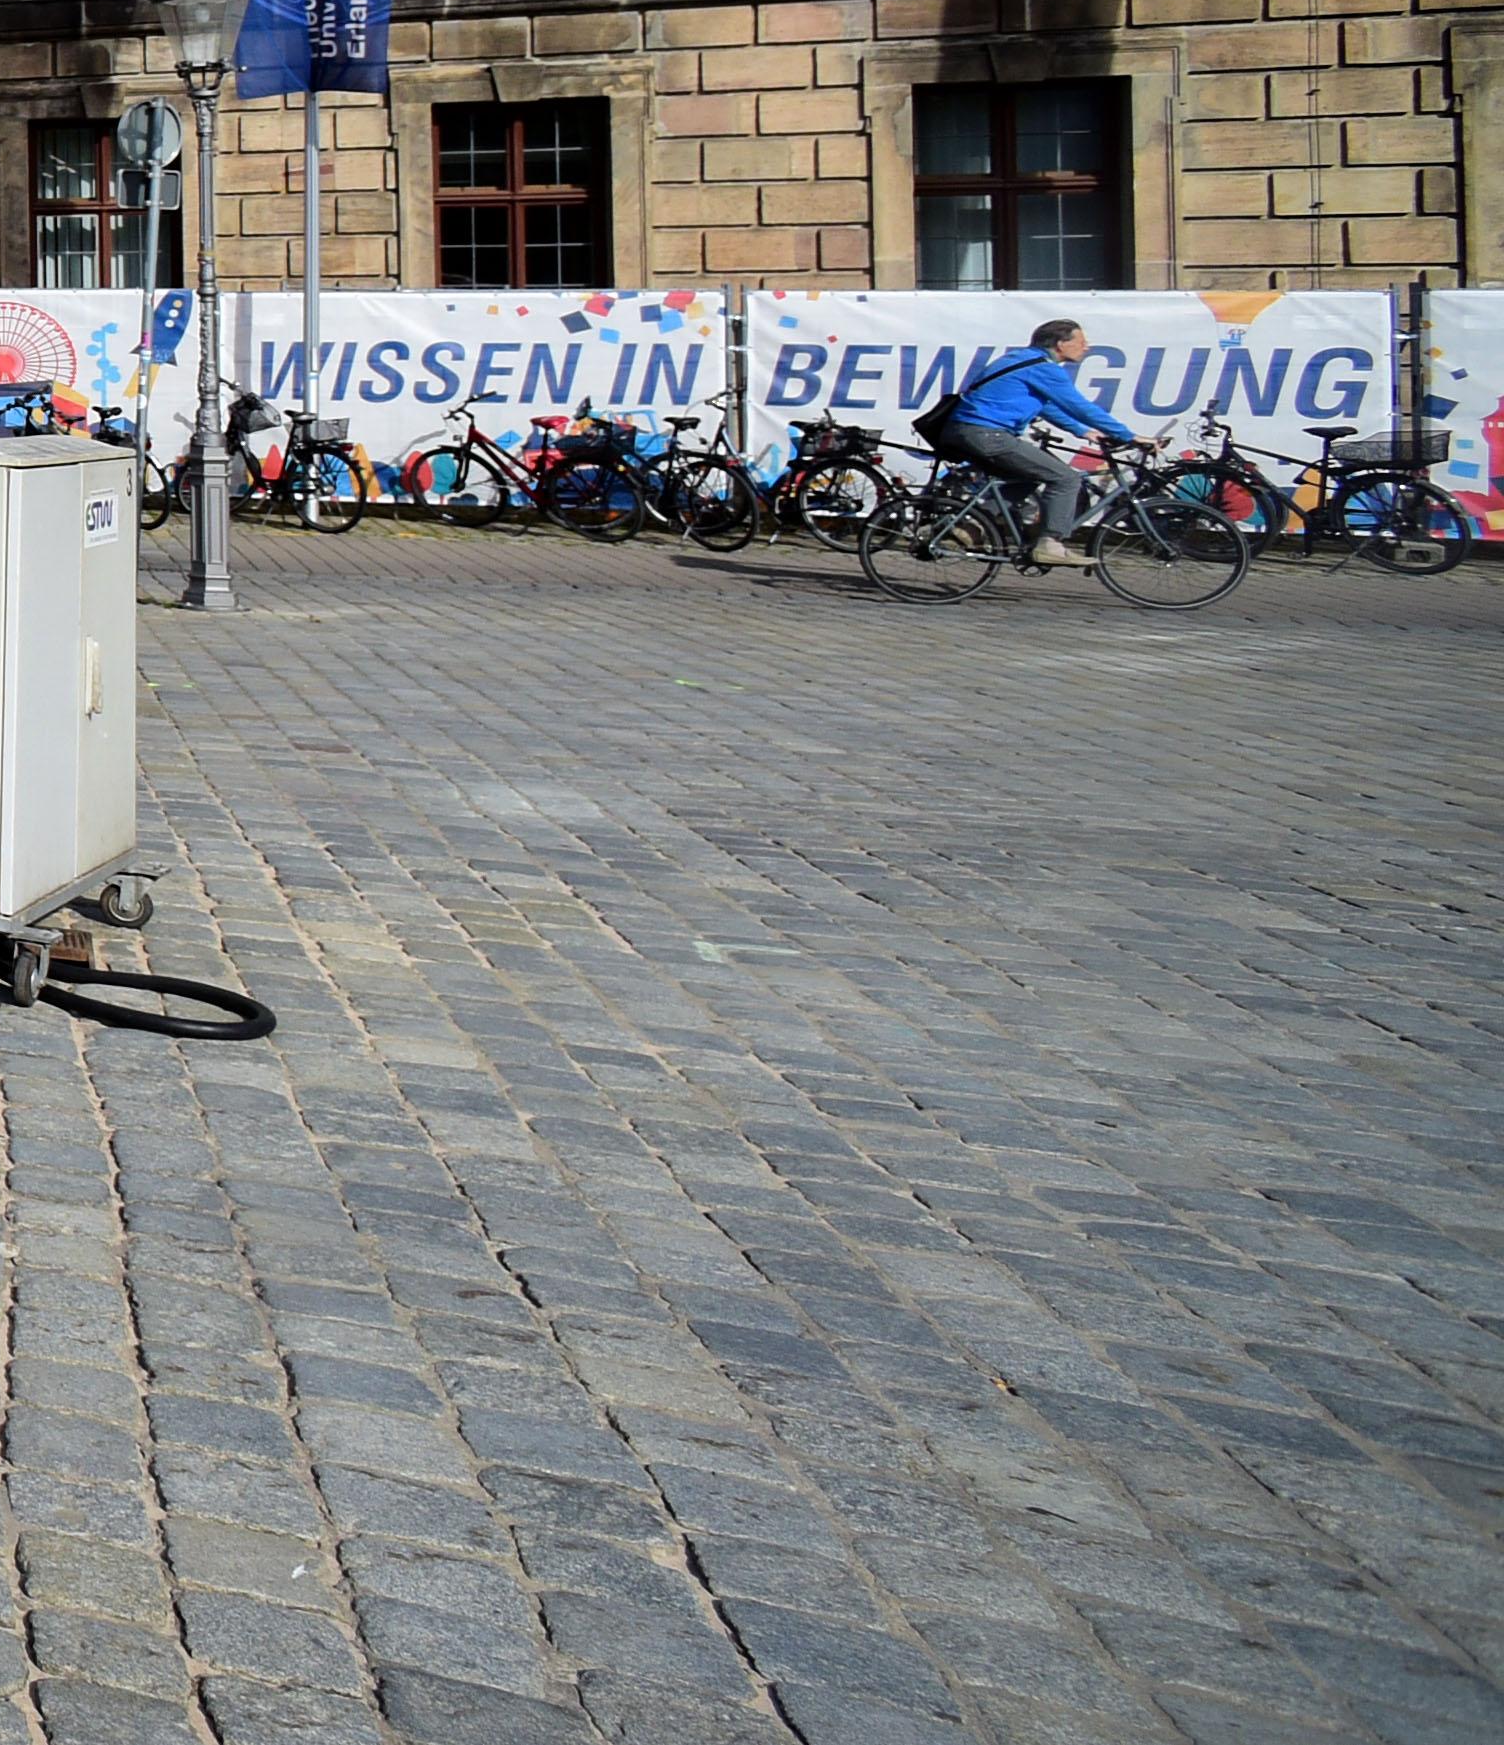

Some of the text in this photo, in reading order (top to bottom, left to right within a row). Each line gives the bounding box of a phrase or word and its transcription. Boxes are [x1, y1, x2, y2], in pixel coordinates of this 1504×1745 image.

[258, 340, 705, 406] WISSEN IN
[764, 342, 1375, 420] BEWGUNG
[126, 467, 133, 497] 3
[85, 499, 114, 531] ESTW
